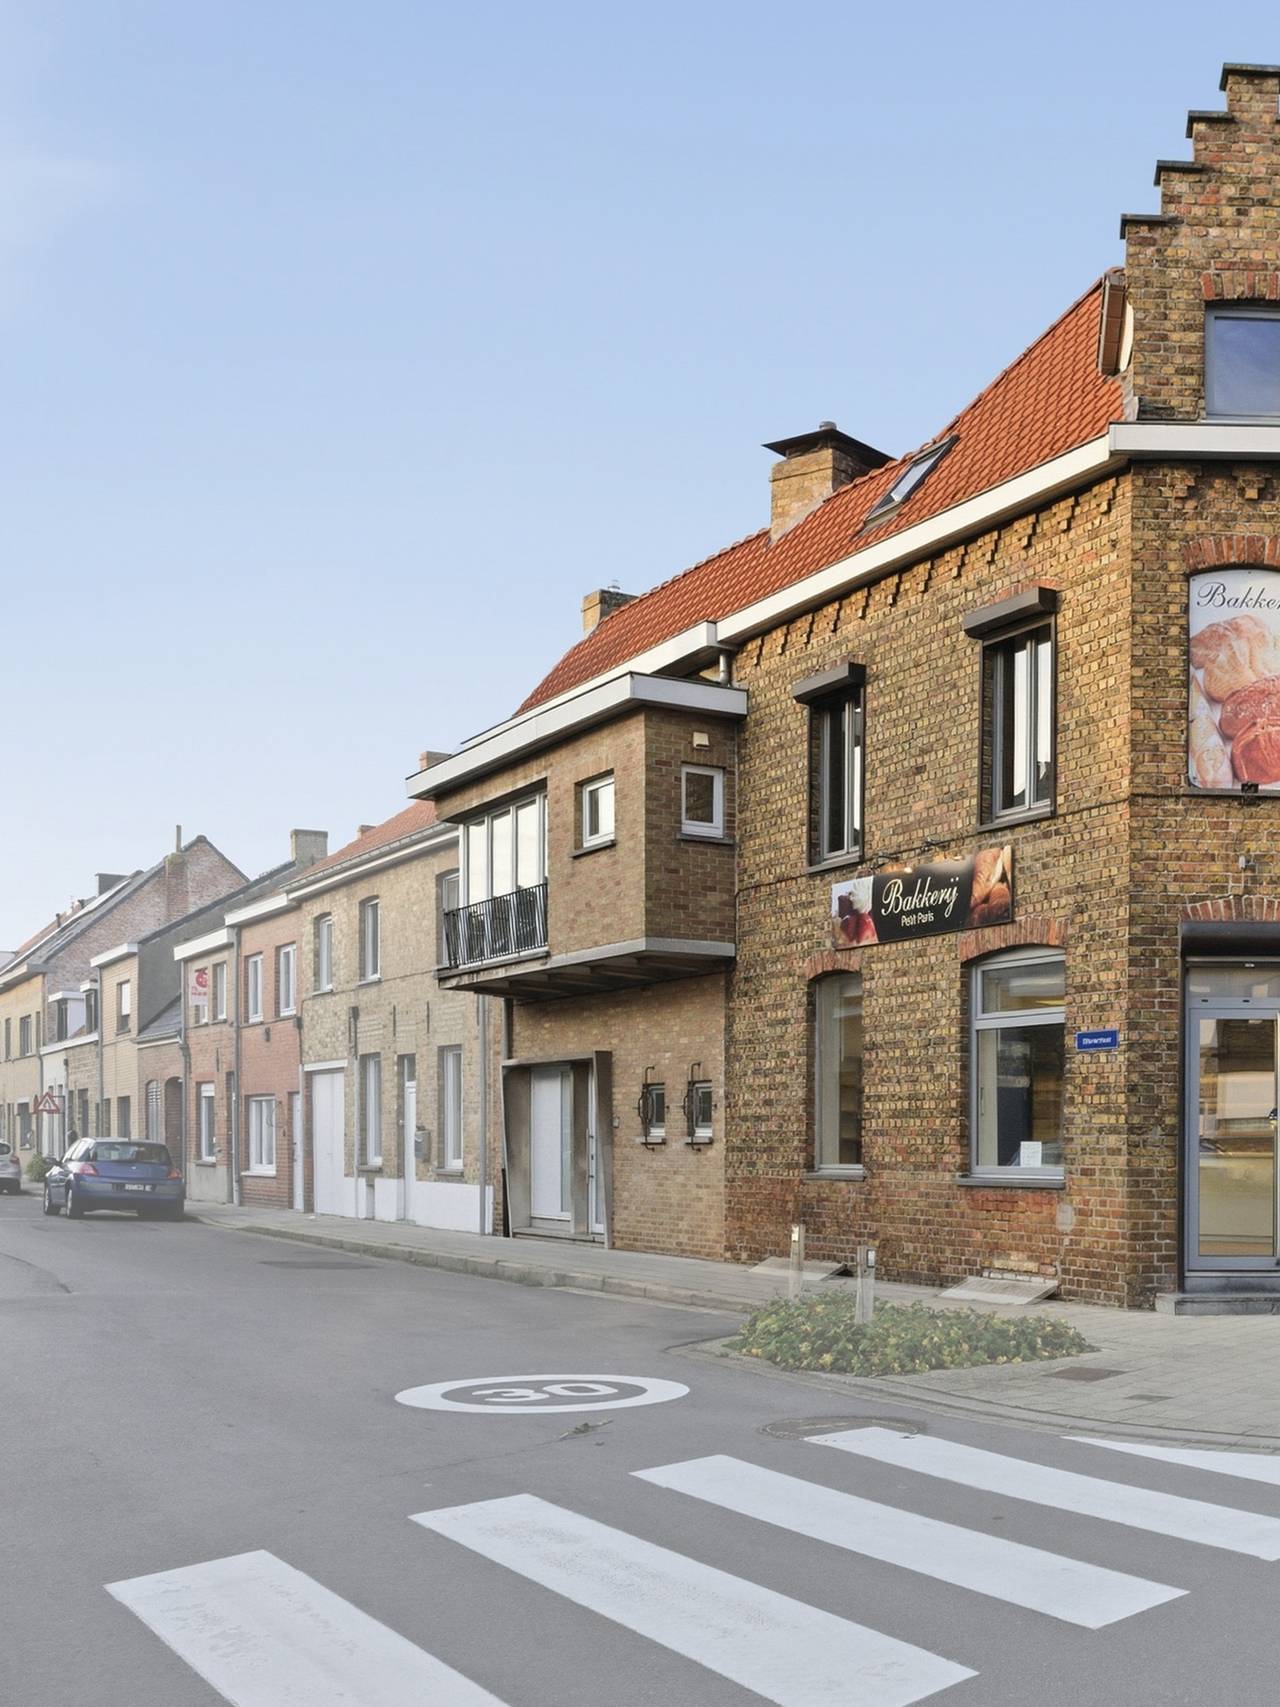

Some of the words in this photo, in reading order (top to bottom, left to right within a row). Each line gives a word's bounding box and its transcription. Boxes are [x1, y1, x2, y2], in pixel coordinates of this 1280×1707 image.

[881, 876, 960, 918] Bakkerij
[901, 914, 916, 927] Petit
[917, 910, 934, 924] Paris
[471, 1383, 618, 1402] 30
